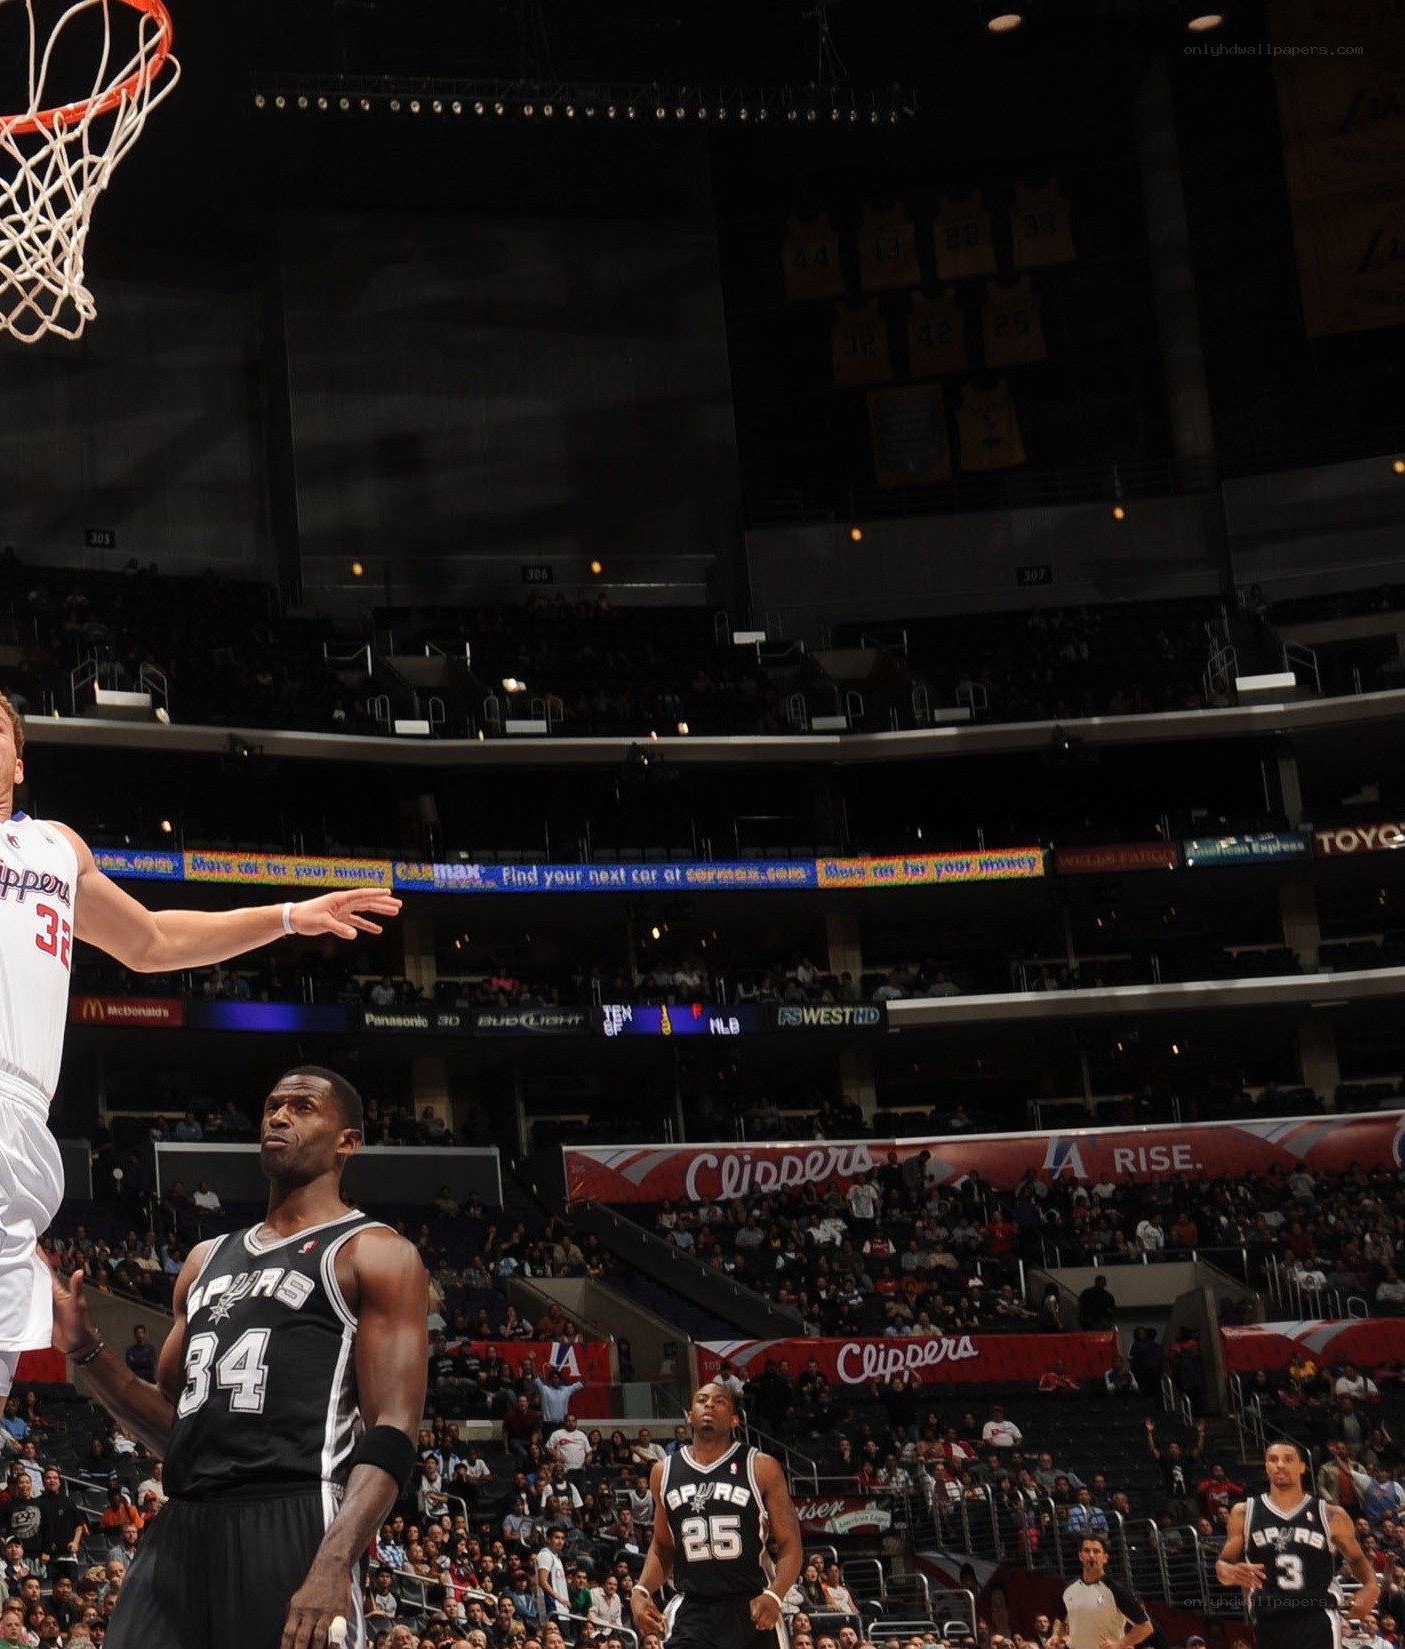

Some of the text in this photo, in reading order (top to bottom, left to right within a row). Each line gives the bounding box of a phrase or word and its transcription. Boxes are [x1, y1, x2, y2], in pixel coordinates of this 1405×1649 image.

[1315, 824, 1405, 855] TOYO
[191, 855, 232, 874] More
[266, 858, 289, 876] for
[293, 861, 329, 880] your
[502, 865, 539, 886] Find
[544, 869, 582, 891] your
[588, 867, 627, 887] next
[631, 868, 658, 884] car
[663, 866, 681, 883] at
[933, 860, 972, 879] your
[978, 855, 1036, 873] money
[35, 902, 71, 972] 32
[107, 1005, 170, 1019] McDonald's
[364, 1012, 460, 1029] Panasonic 3D
[685, 1143, 875, 1201] Clippers
[1042, 1134, 1202, 1180] LA RISE.
[187, 1267, 316, 1325] SPURS
[176, 1327, 272, 1419] 34
[549, 1341, 582, 1377] LA
[836, 1334, 979, 1386] Clippers
[665, 1481, 752, 1513] SPURS
[681, 1514, 743, 1563] 25
[1251, 1526, 1326, 1552] SPURS
[1274, 1553, 1305, 1591] 3
